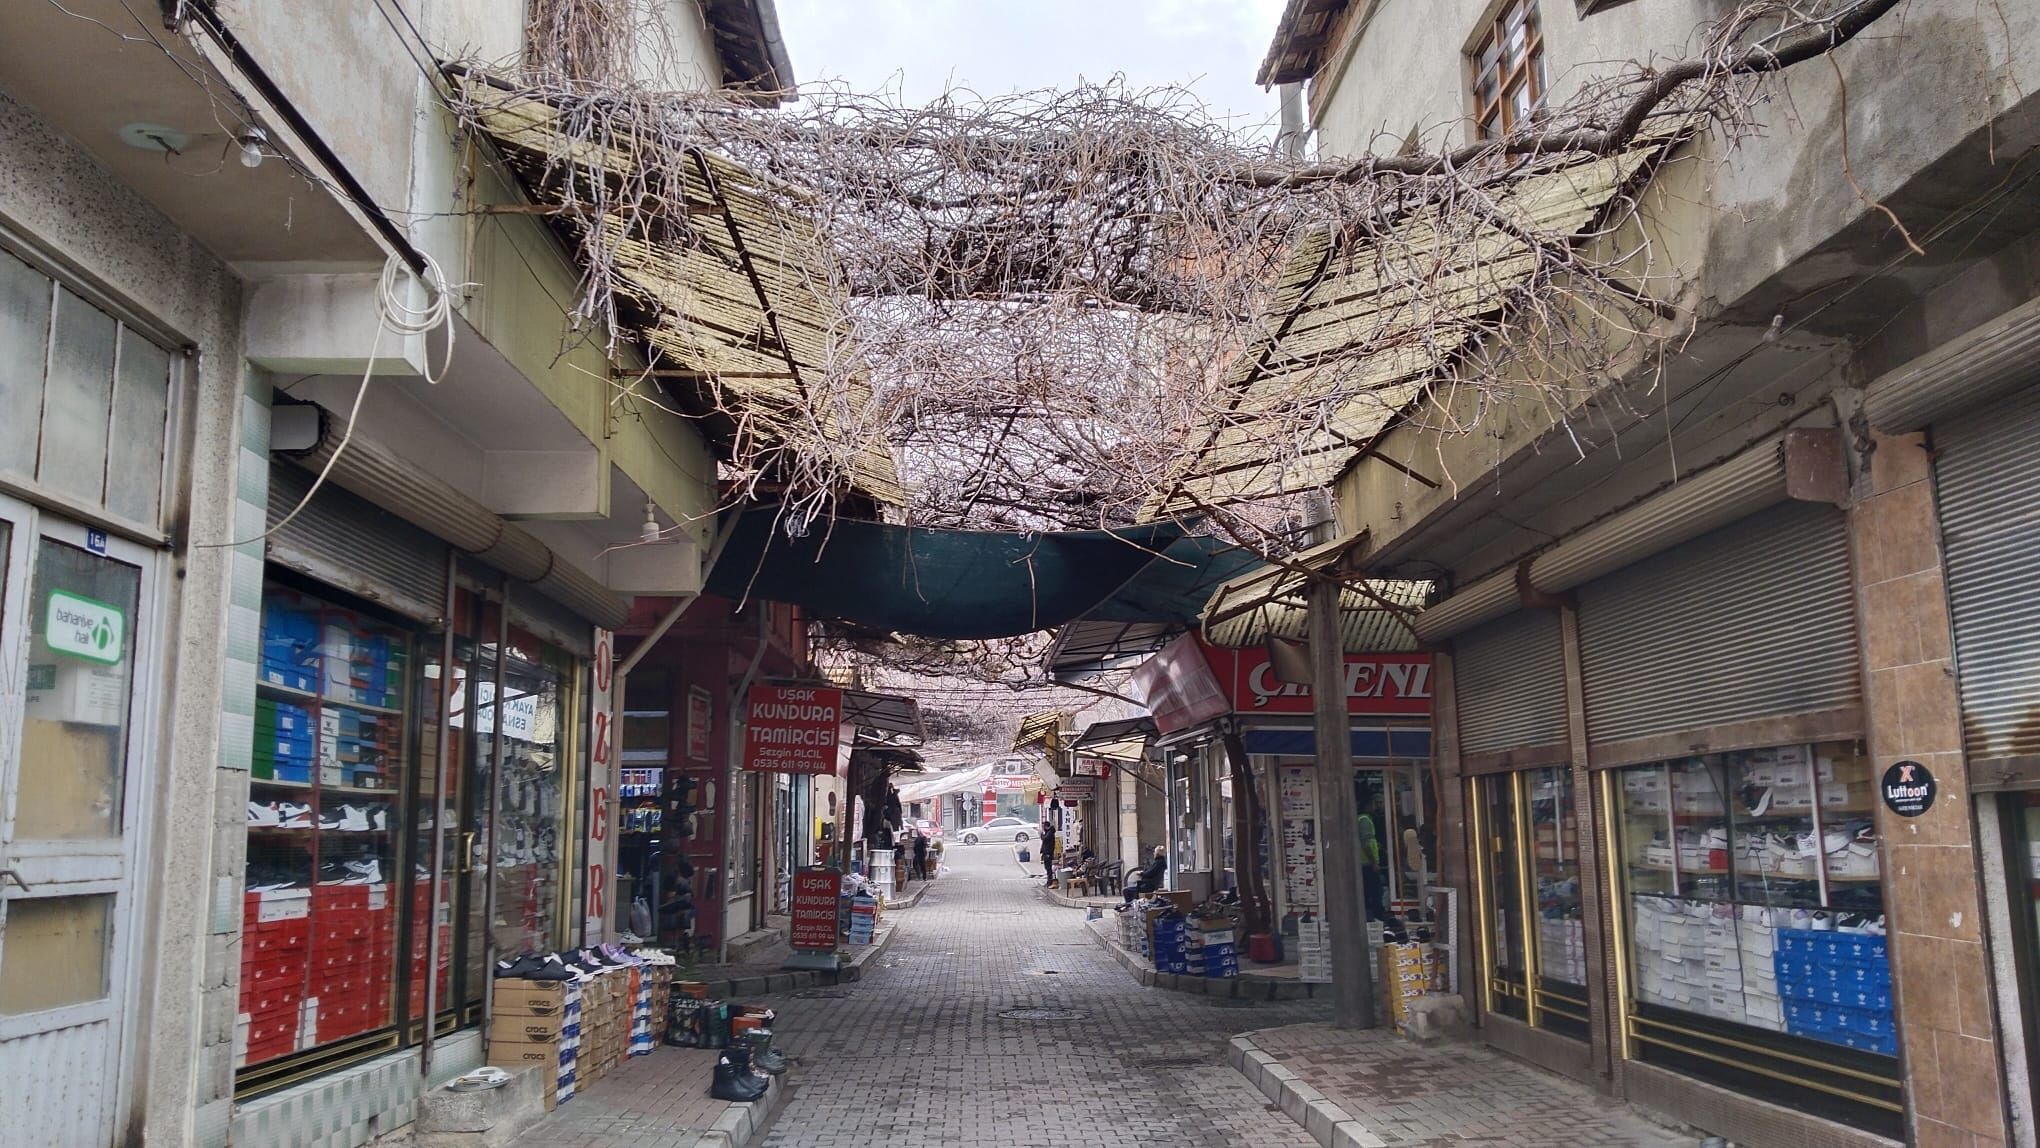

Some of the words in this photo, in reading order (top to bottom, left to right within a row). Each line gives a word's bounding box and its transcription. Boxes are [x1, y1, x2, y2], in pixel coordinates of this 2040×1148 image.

[778, 689, 815, 703] UŞAK
[753, 703, 834, 721] KUNDURA
[751, 726, 835, 745] TAMİRCİSİ
[759, 747, 792, 759] Sezgin
[752, 758, 779, 768] 0535
[781, 760, 795, 769] 611
[797, 761, 810, 769] 99
[813, 762, 827, 770] 44
[803, 879, 831, 891] UŞAK
[797, 896, 835, 905] KUNDURA
